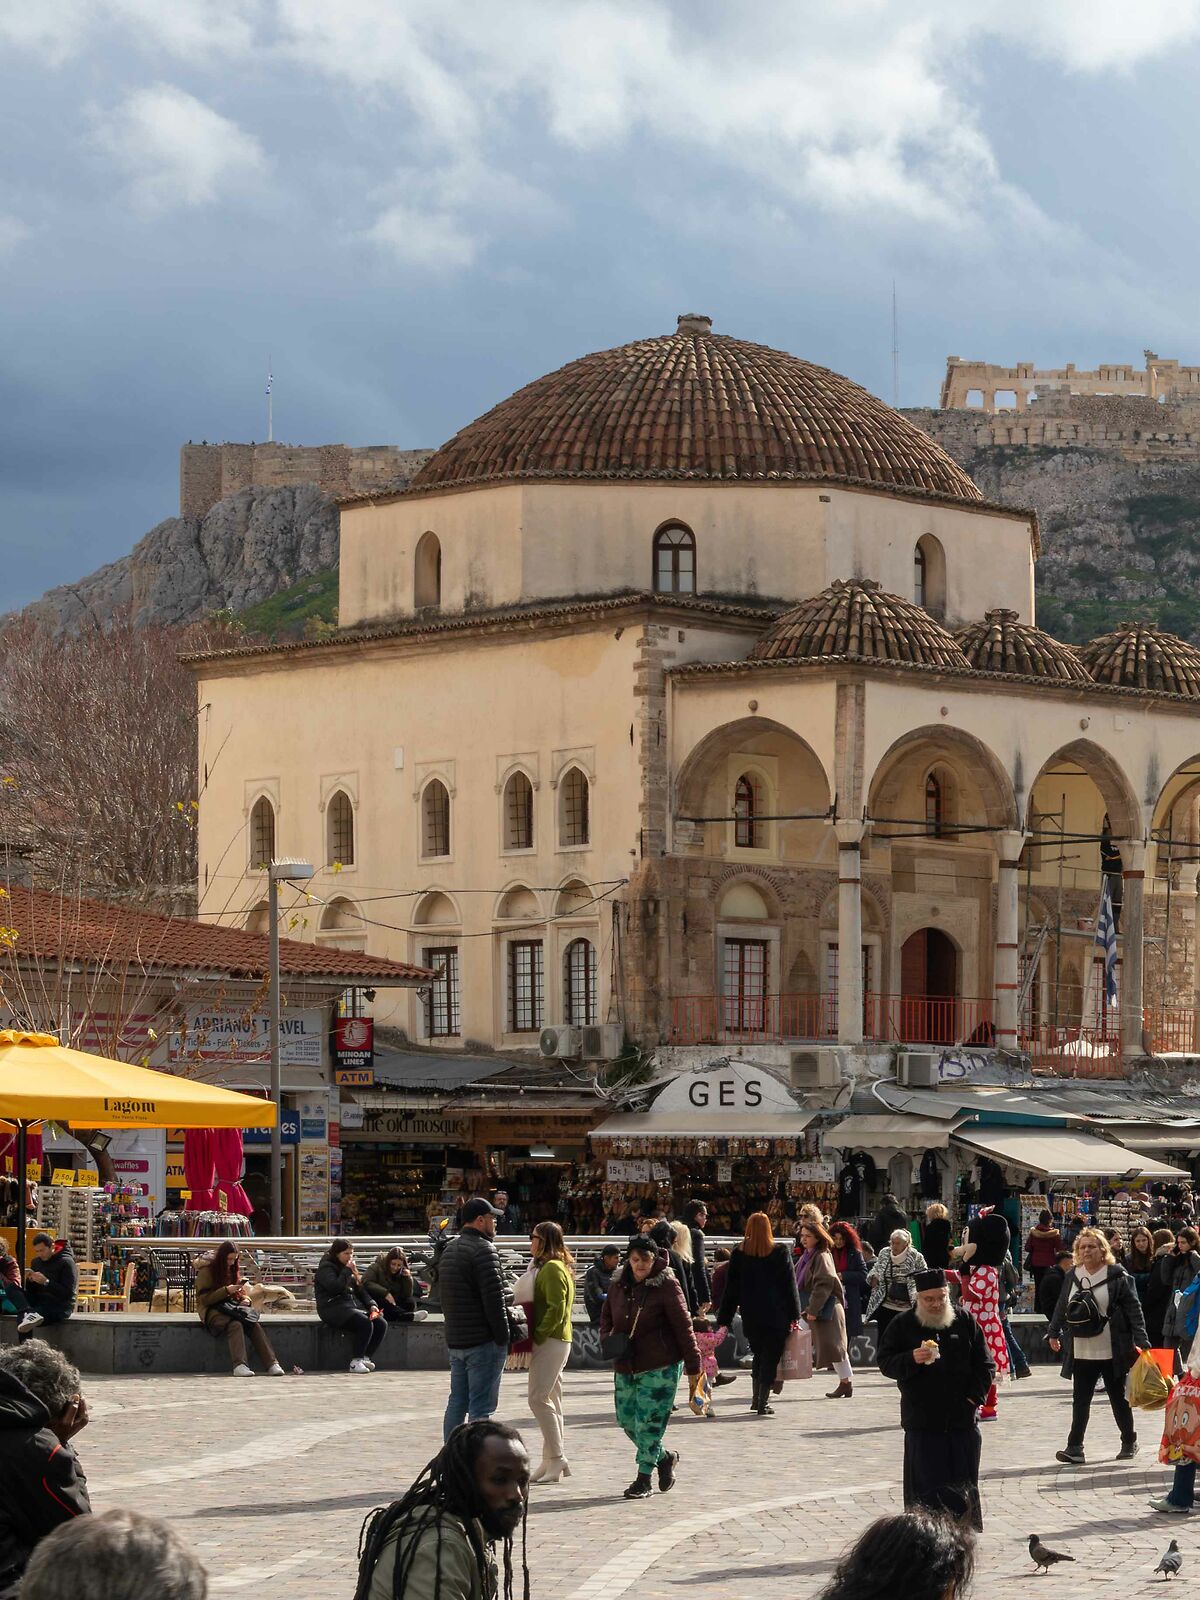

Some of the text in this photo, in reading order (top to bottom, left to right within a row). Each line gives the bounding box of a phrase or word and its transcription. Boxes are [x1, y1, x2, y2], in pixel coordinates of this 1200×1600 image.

[262, 1019, 307, 1035] TAVEL
[340, 1073, 369, 1082] ATM
[688, 1080, 762, 1107] GES
[104, 1098, 155, 1114] Lagom
[386, 1117, 408, 1134] old
[412, 1118, 464, 1136] mosque
[114, 1161, 139, 1170] waffles
